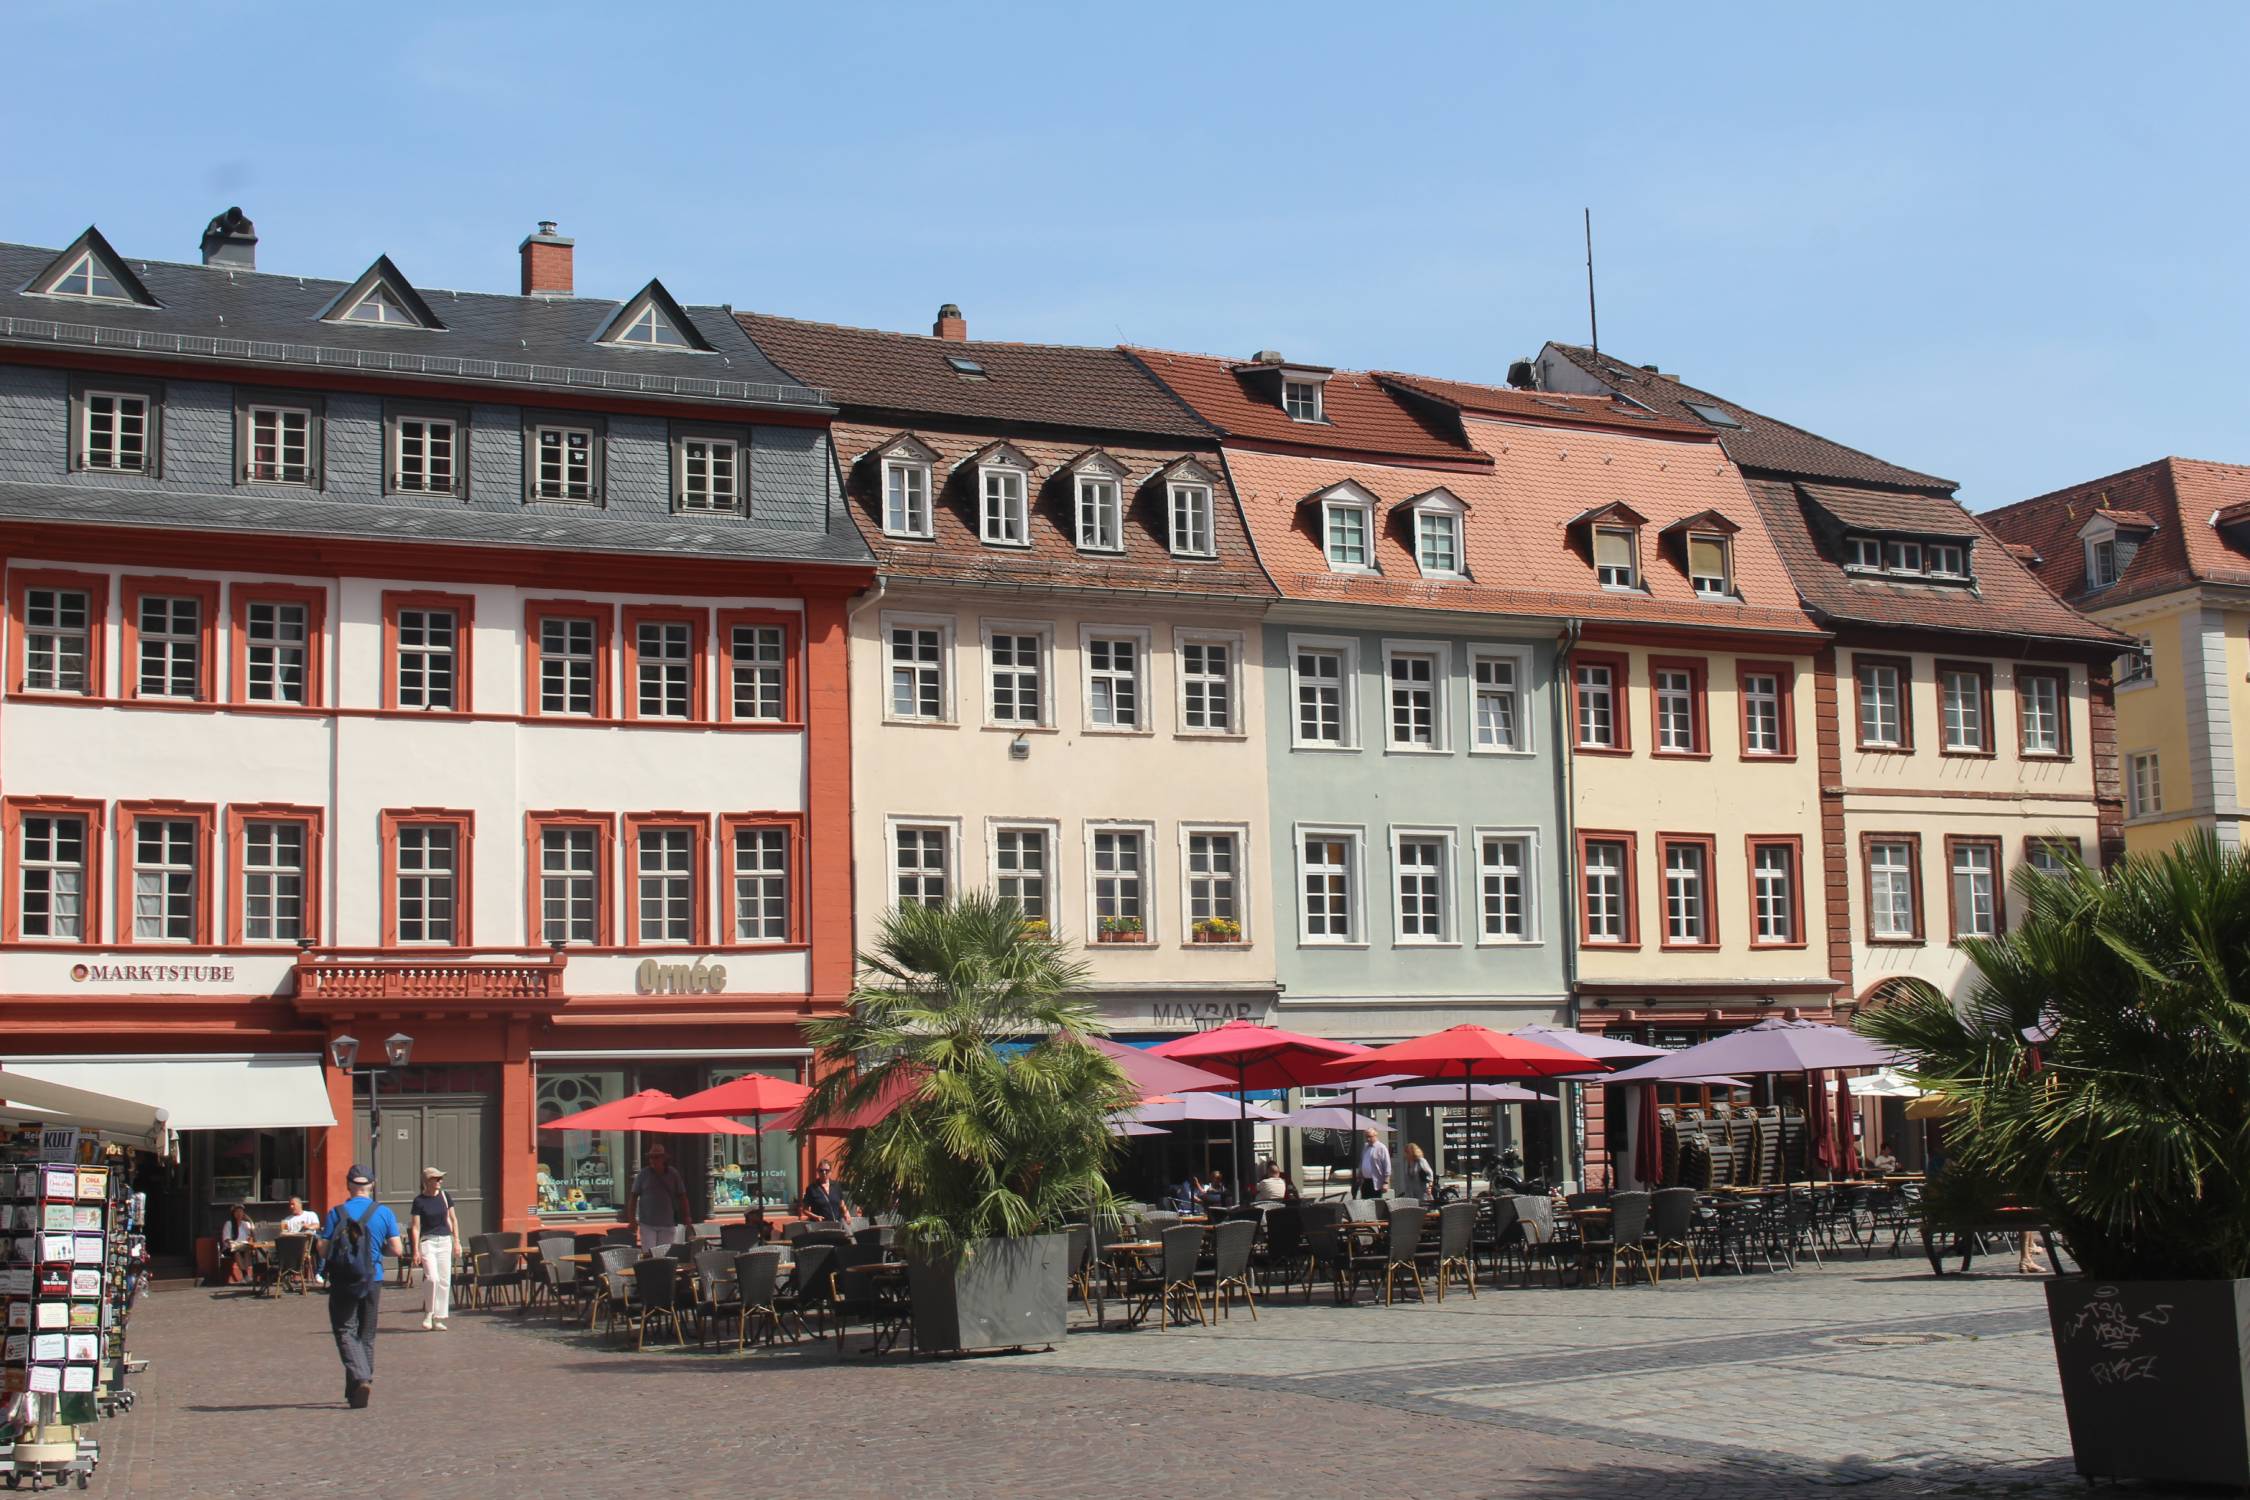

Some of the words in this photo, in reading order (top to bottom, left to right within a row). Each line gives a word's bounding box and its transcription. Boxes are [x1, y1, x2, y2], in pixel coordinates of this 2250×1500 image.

[91, 965, 235, 982] MARKTSTUBE
[637, 954, 727, 994] Ornée
[44, 1132, 74, 1148] KULT
